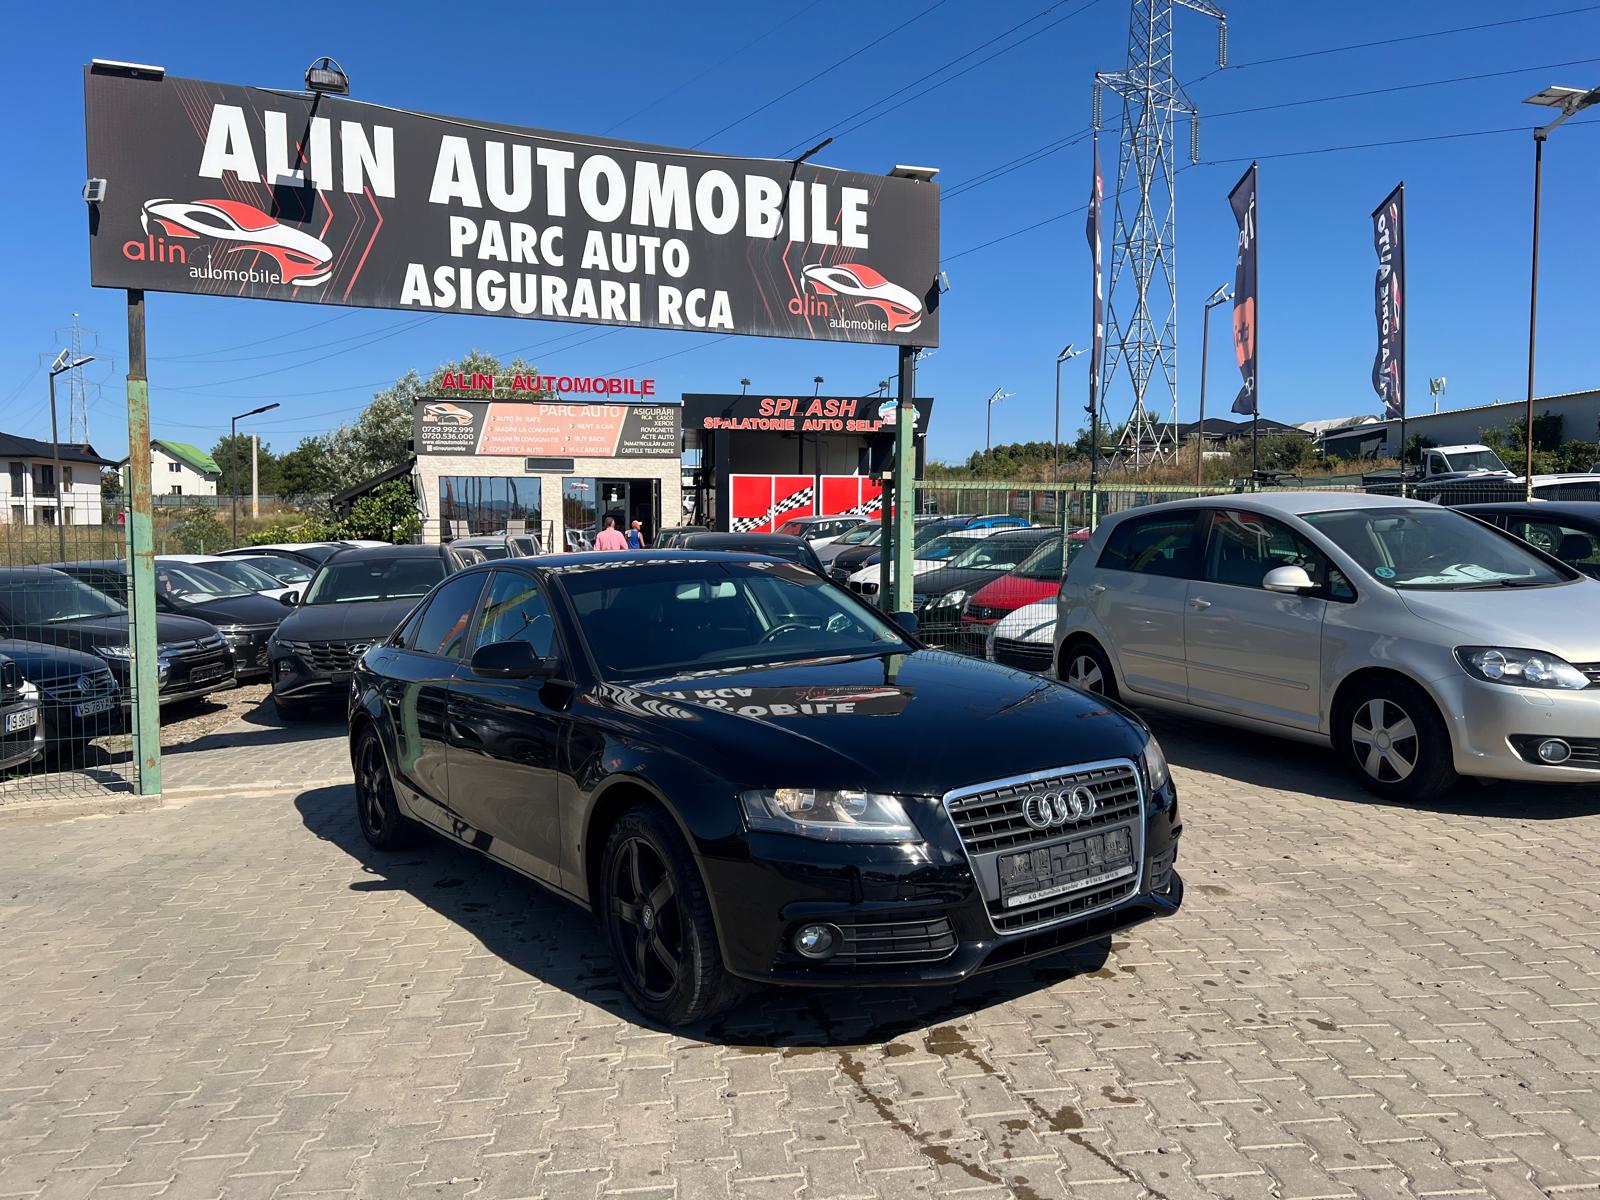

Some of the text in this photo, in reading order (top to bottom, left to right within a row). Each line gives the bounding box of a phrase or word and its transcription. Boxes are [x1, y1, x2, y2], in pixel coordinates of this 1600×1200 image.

[199, 104, 869, 249] ALIN AUTOMOBILE
[122, 234, 186, 264] alin
[450, 215, 690, 278] PARC AUTO
[189, 259, 281, 284] automobile
[400, 263, 735, 330] ASIGURARI RCA
[788, 293, 828, 317] alin
[829, 313, 888, 331] automobile
[441, 373, 656, 395] ALIN AUTOMOBILE
[540, 405, 620, 418] PARC AUTO
[758, 398, 858, 417] SPLASH
[703, 417, 795, 430] SPALATORIE
[802, 419, 843, 431] AUTO
[846, 420, 883, 432] SELF
